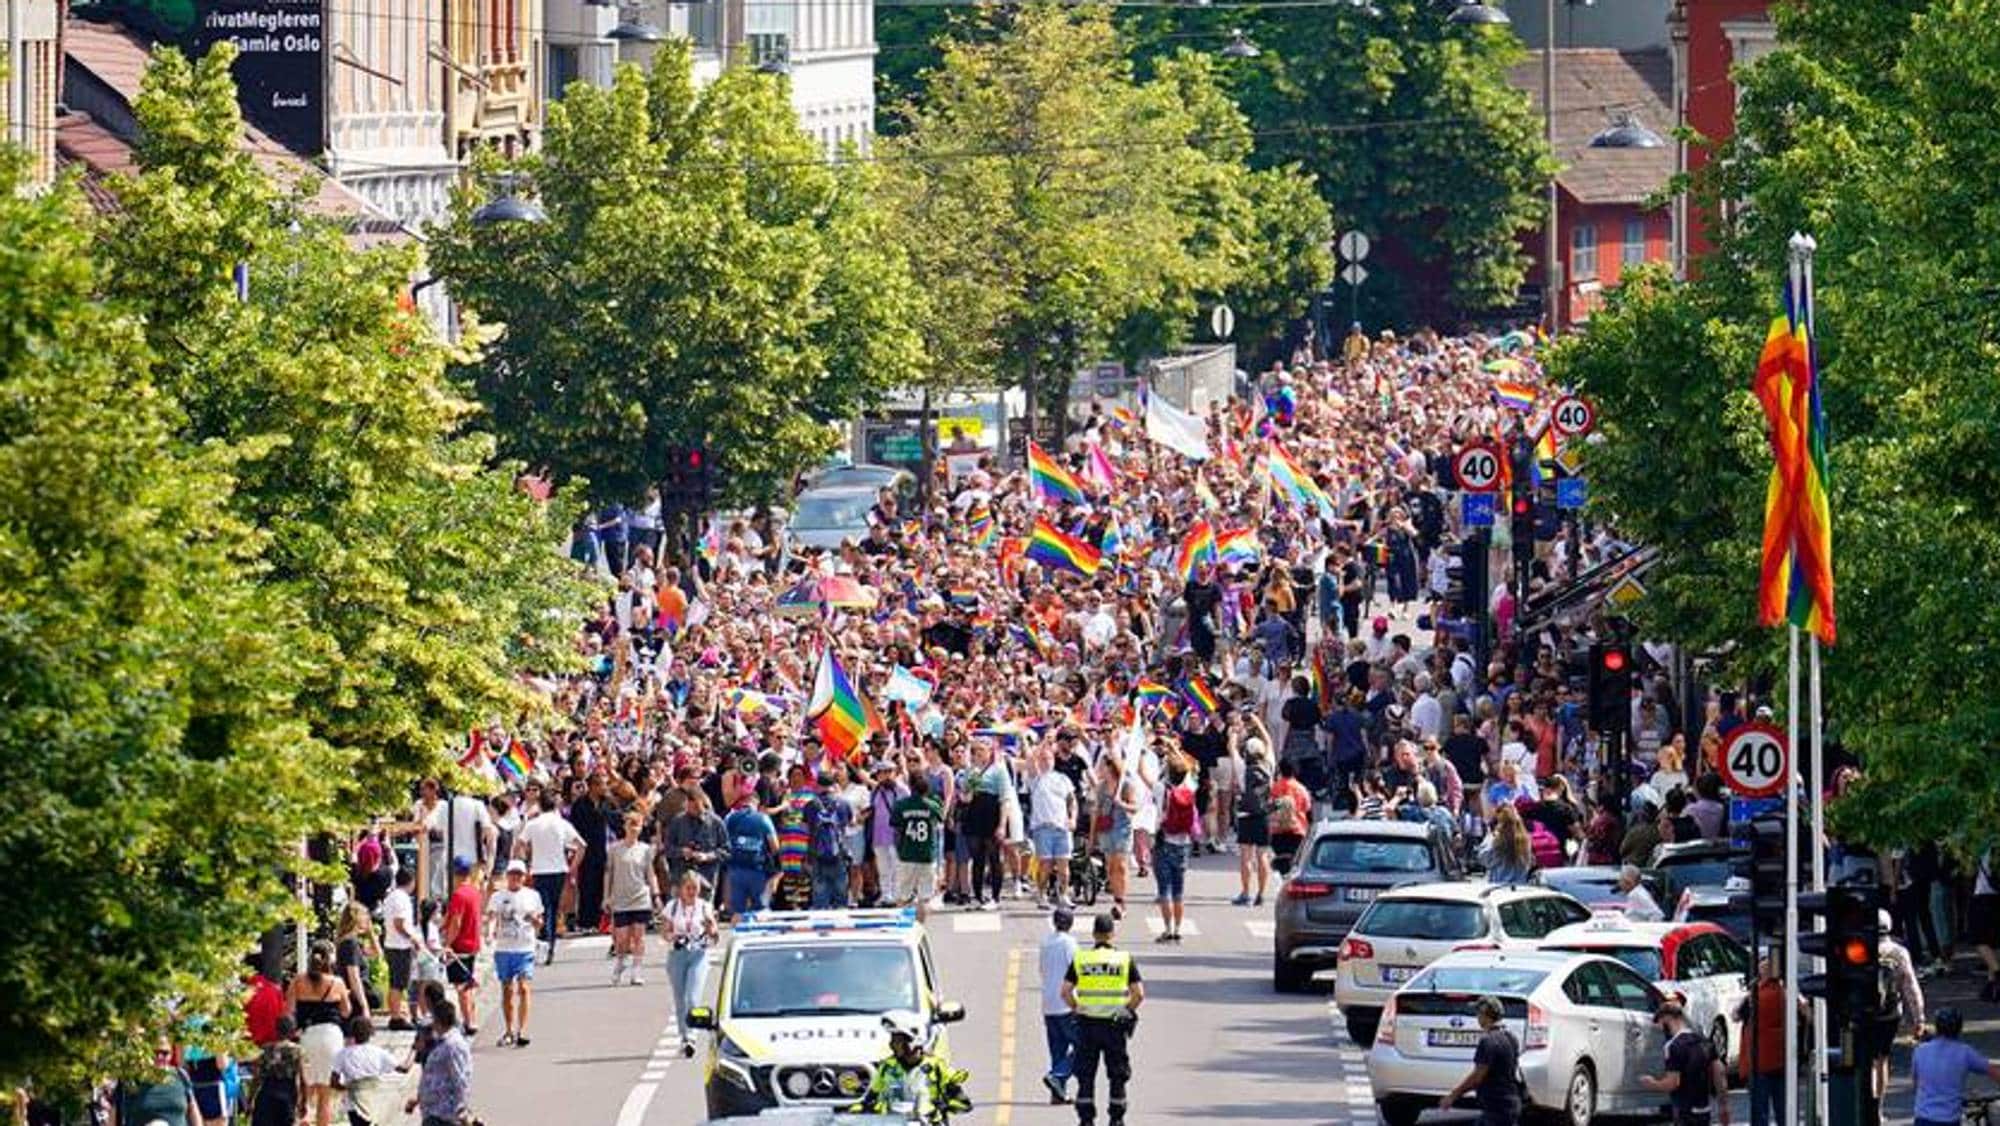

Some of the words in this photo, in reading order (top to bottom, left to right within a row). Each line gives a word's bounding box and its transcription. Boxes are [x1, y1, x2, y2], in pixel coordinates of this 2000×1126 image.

[283, 34, 320, 51] Oslo
[1559, 407, 1587, 426] 40
[1463, 455, 1496, 479] 40
[1731, 741, 1782, 778] 40
[905, 811, 929, 842] 48
[769, 1028, 877, 1043] POLITI
